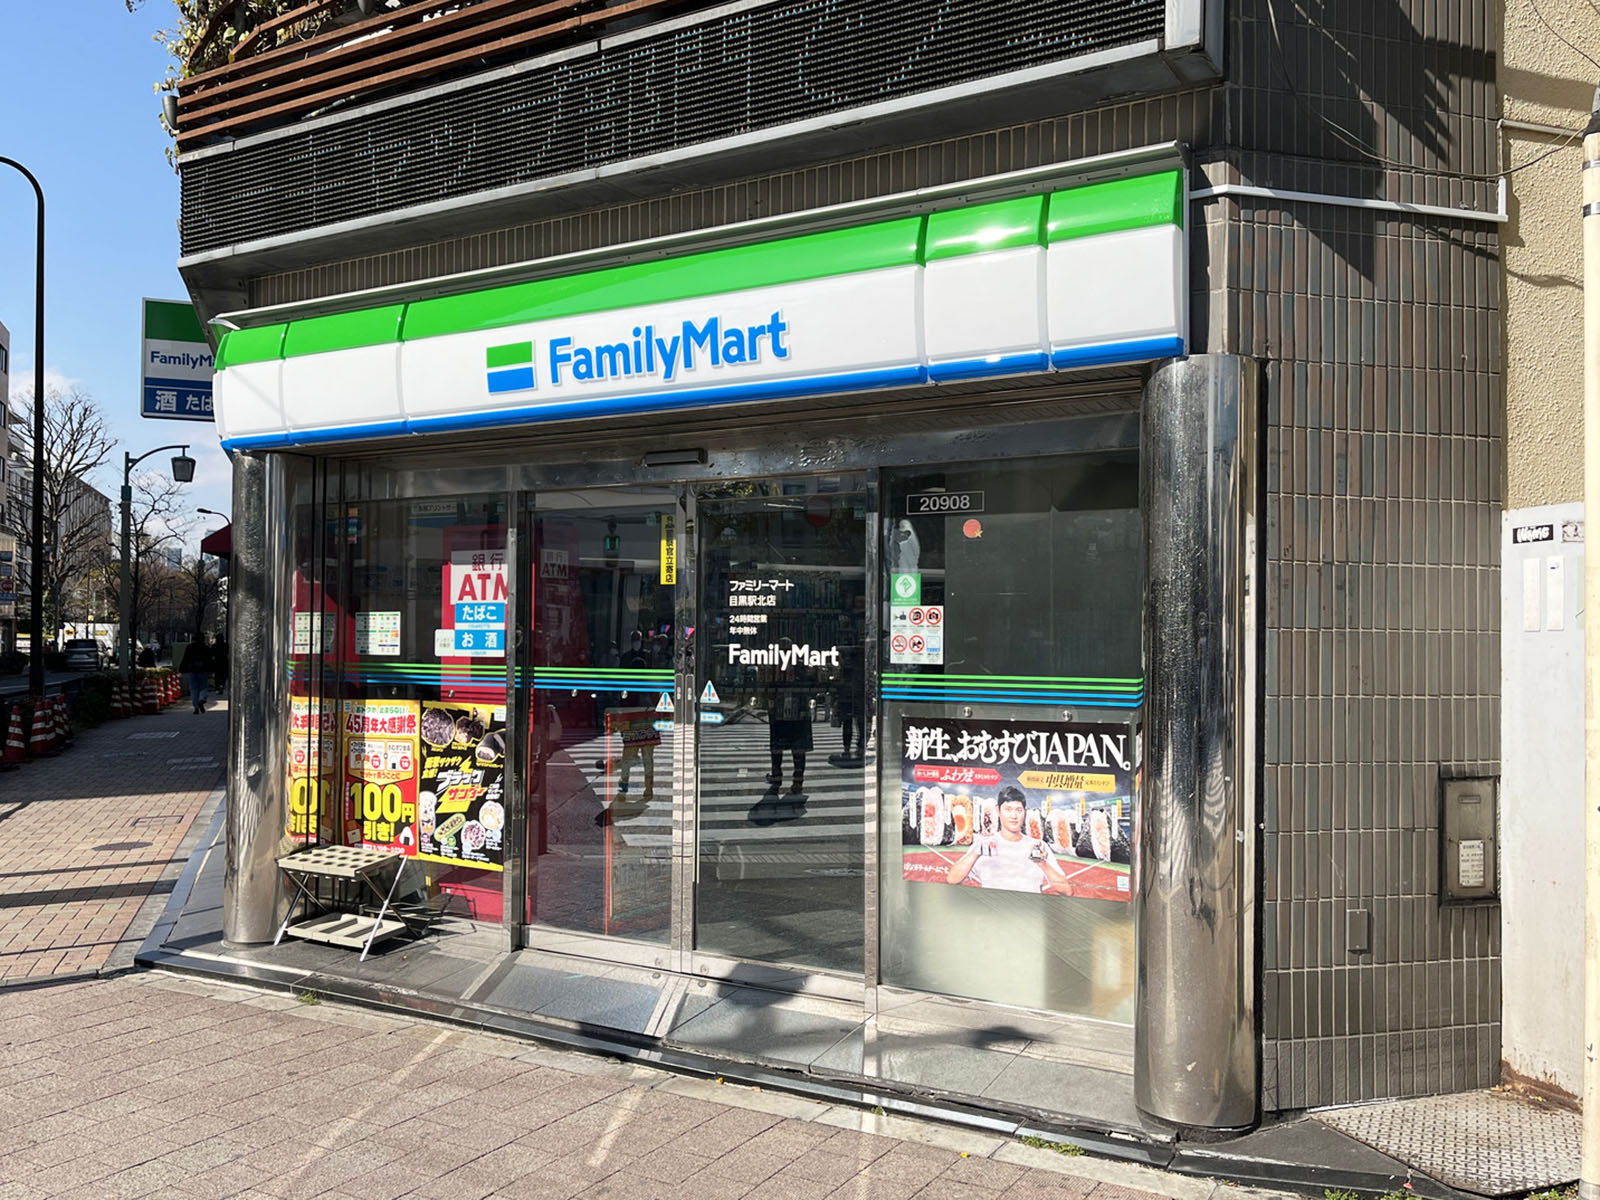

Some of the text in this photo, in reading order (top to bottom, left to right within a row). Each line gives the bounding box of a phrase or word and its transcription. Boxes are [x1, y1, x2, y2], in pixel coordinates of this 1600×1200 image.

[549, 311, 787, 384] FamilyMart
[150, 350, 215, 369] FamilyM
[155, 390, 177, 412] 酒
[919, 494, 970, 511] 20908
[472, 553, 504, 571] 銀行
[542, 563, 567, 577] ATM
[457, 573, 508, 601] ATM
[729, 579, 795, 591] ファミリーマート
[729, 595, 776, 607] 目黒駅北店
[462, 605, 497, 621] たばこ
[729, 614, 768, 624] 24時間営業
[729, 626, 757, 636] 年中無休
[728, 643, 839, 671] FamilyMart
[346, 713, 417, 734] 45周年大感謝祭
[904, 725, 1131, 771] 新生、おむすびJAPAN。
[436, 769, 485, 793] ブラック
[351, 782, 415, 823] 100円
[448, 785, 486, 801] サンダー
[363, 820, 395, 843] 引き!
